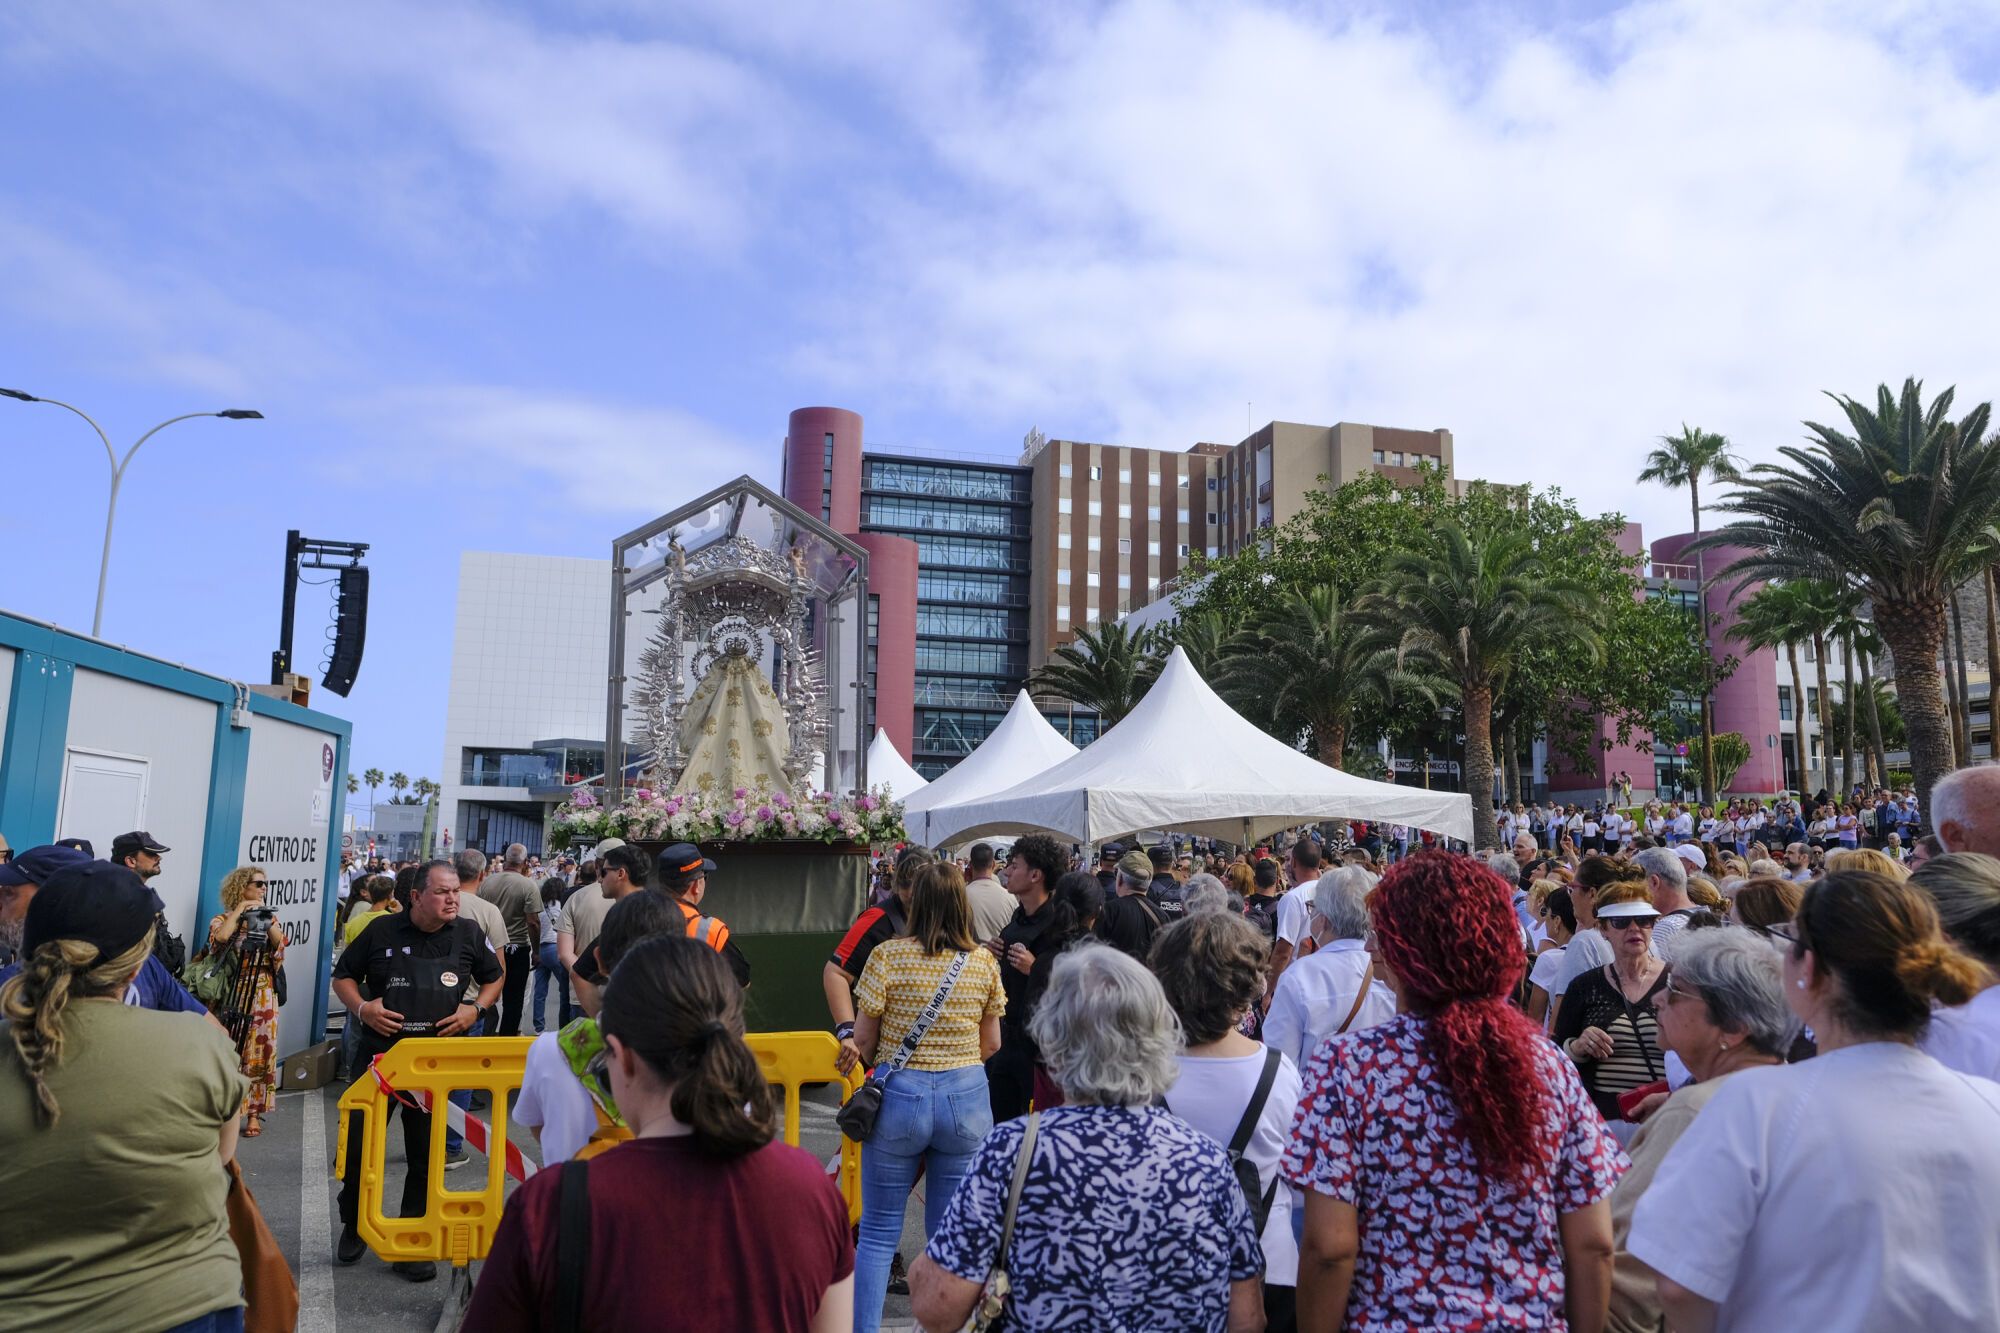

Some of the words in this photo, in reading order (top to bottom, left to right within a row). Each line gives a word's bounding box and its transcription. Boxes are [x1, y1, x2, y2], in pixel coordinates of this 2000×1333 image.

[249, 835, 299, 863] CENTRO
[301, 838, 317, 862] DE
[301, 879, 317, 903] DE
